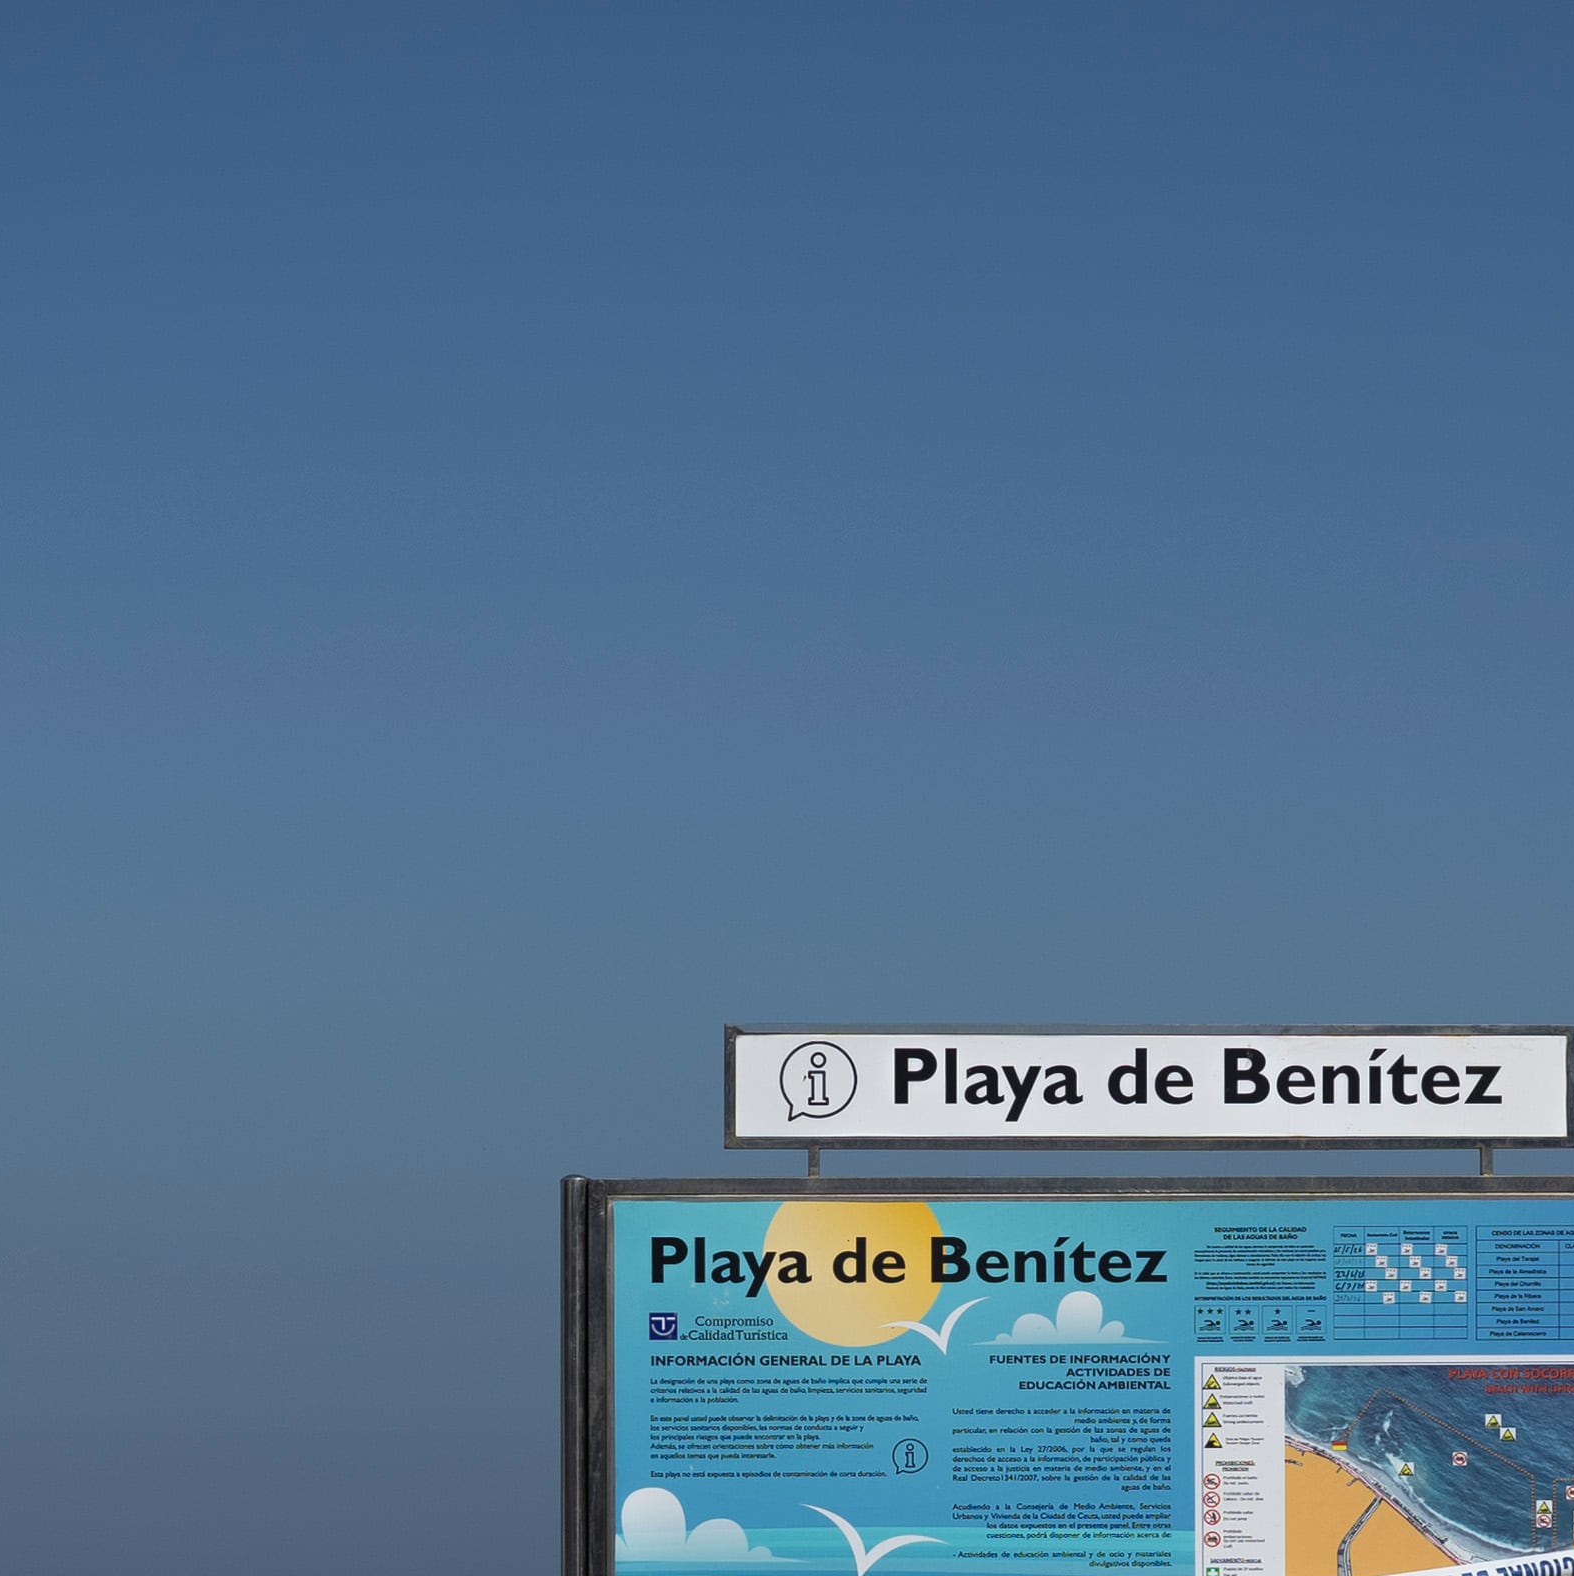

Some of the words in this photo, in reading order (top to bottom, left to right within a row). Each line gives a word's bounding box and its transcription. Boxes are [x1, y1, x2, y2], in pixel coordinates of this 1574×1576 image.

[894, 1047, 1083, 1121] Playa
[1107, 1047, 1193, 1104] de
[1223, 1047, 1502, 1104] Benítez
[652, 1237, 812, 1300] Playa
[832, 1236, 905, 1284] de
[930, 1236, 1166, 1284] Benítez
[694, 1315, 773, 1328] Compromiso
[688, 1329, 735, 1341] Calidad
[736, 1329, 788, 1341] Turística
[650, 1352, 755, 1366] INFORMACIÓN
[759, 1354, 827, 1366] GENERAL
[830, 1354, 850, 1366] DE
[854, 1354, 873, 1366] LA
[876, 1354, 921, 1366] PLAYA
[989, 1354, 1046, 1364] FUENTES
[1049, 1354, 1066, 1364] DE
[1069, 1353, 1160, 1364] INFORMACIÓN
[1162, 1354, 1170, 1364] Y
[1065, 1367, 1150, 1377] ACTIVIDADES
[1153, 1367, 1170, 1376] DE
[1018, 1378, 1095, 1390] EDUCACIÓN
[1097, 1380, 1171, 1390] AMBIENTAL
